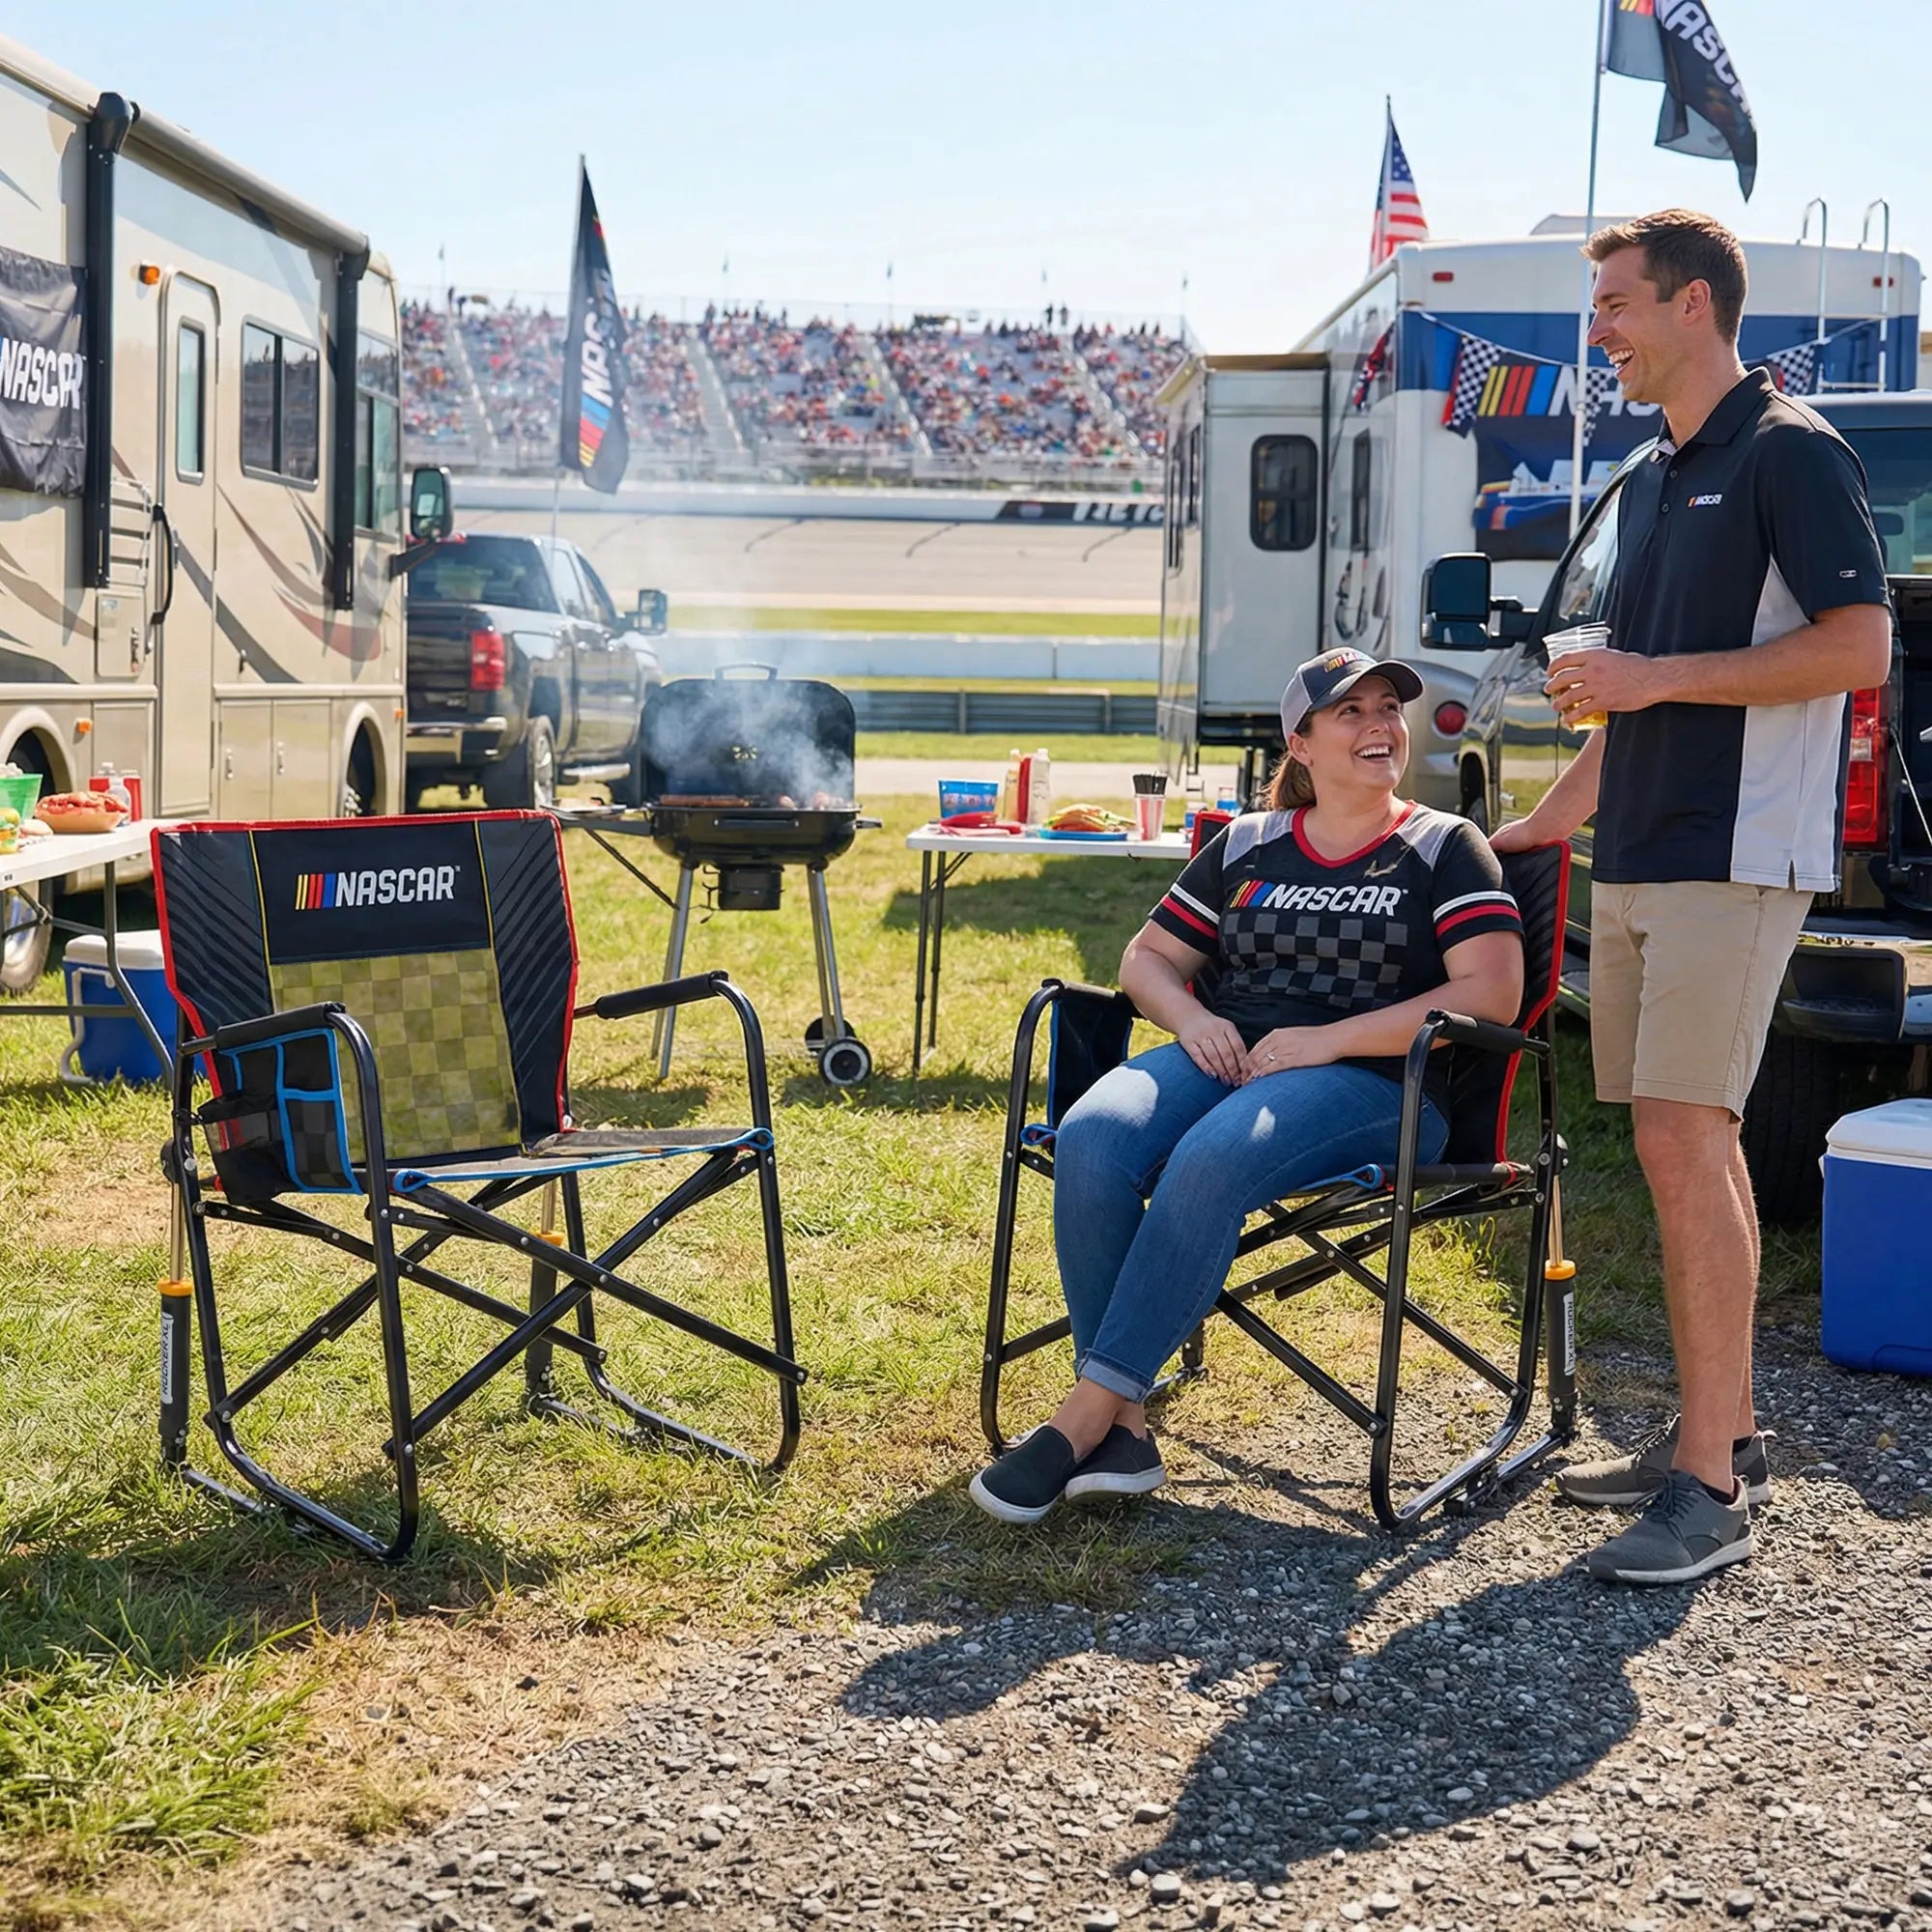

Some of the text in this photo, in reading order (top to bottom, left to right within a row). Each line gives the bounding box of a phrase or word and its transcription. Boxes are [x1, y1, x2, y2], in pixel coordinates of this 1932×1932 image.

[335, 866, 454, 907] NASCAR
[1262, 883, 1402, 917] NASCAR
[160, 1323, 171, 1395] ROCKER XL
